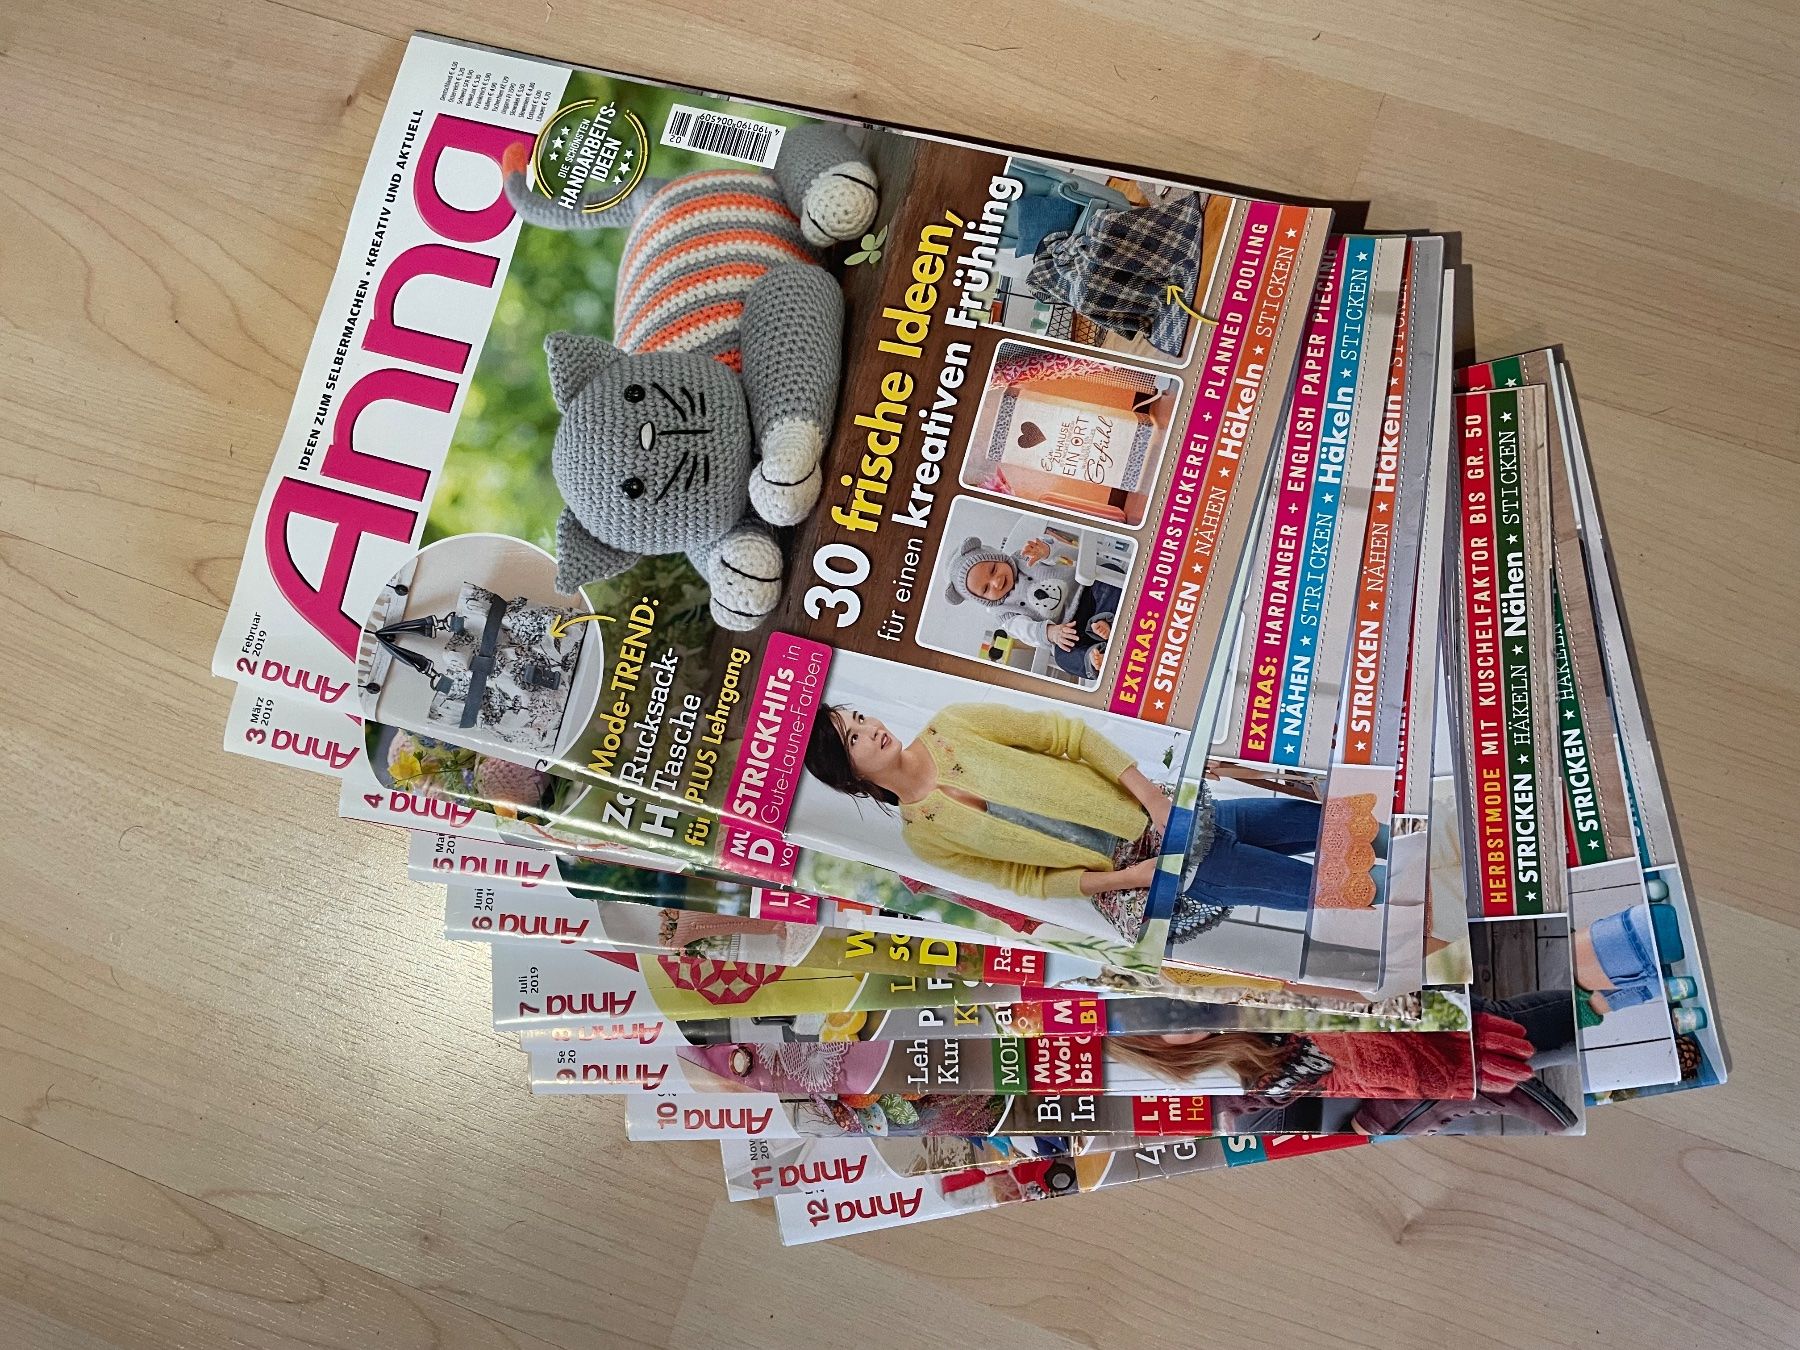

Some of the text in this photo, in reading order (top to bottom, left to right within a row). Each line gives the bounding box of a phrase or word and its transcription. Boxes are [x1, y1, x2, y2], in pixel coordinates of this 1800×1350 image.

[557, 117, 591, 178] DIE SCHÖNSTEN
[557, 97, 619, 210] HANDARBEITS-
[668, 134, 681, 144] 02
[589, 135, 622, 183] IDEEN
[298, 107, 424, 471] IDEEN ZUM SELBERMACHEN KREATIV UND AKTUELL
[1311, 247, 1340, 324] PIECING
[1300, 332, 1327, 396] PAPER
[265, 113, 537, 664] Anna
[877, 169, 1025, 643] für einen kreativen Frühling
[803, 202, 964, 628] 30 frische Ideen,
[1069, 415, 1089, 447] ORT
[1464, 413, 1482, 438] 50
[1039, 448, 1056, 472] Ein
[1052, 421, 1070, 463] ZUHAUSE
[1082, 415, 1124, 486] Gefühl
[1285, 405, 1317, 492] ENGLISH
[1062, 451, 1080, 476] EIN
[1117, 608, 1161, 704] EXTRAS:
[1145, 430, 1211, 602] AJOURSTICKEREI
[1203, 309, 1245, 401] PLANNED
[1231, 220, 1270, 303] POOLING
[1150, 244, 1296, 694] STRICKEN NÄHEN Häkeln STICKEN
[1465, 445, 1484, 479] GR.
[1276, 267, 1370, 736] NÄHEN STRICKEN Häkeln STICKEN
[1467, 491, 1487, 524] BIS
[1364, 522, 1391, 592] NÄHEN
[1263, 523, 1300, 646] HARDANGER
[240, 610, 263, 654] Februar
[1470, 536, 1496, 706] KUSCHELFAKTOR
[251, 629, 268, 656] 2019
[1498, 429, 1538, 883] STRICKEN HÄKELN Nähen STICKEN
[236, 657, 258, 675] 2
[261, 660, 350, 703] Anna
[1349, 618, 1382, 733] STRICKEN
[586, 592, 660, 778] Mode-TREND:
[1246, 654, 1279, 751] EXTRAS:
[250, 697, 264, 724] März
[261, 700, 274, 726] 2019
[618, 642, 681, 786] Rucksack-
[684, 644, 752, 804] PLUS Lehrgang
[246, 728, 267, 744] 3
[271, 728, 360, 769] Anna
[650, 690, 703, 796] Tasche
[731, 642, 801, 819] STRICKHITs in
[758, 648, 825, 826] Gute-Laune-Farben
[1479, 719, 1499, 755] MIT
[1561, 727, 1599, 833] STRICKEN
[364, 793, 384, 808] 4
[389, 791, 477, 828] Anna
[1483, 766, 1508, 903] HERBSTMODE
[433, 858, 454, 872] 5
[460, 856, 550, 888] Anna
[474, 888, 483, 910] Juni
[472, 916, 492, 931] 6
[499, 914, 589, 944] Anna
[531, 967, 539, 994] 2019
[1015, 956, 1035, 973] in
[519, 976, 528, 994] Juli
[519, 1002, 540, 1017] 7
[547, 991, 636, 1018] Anna
[582, 1064, 668, 1090] Anna
[1034, 1038, 1050, 1083] Mus
[1075, 1053, 1092, 1084] bis
[657, 1102, 677, 1129] 10
[684, 1108, 773, 1134] Anna
[1163, 1096, 1181, 1121] mi
[752, 1165, 773, 1190] 11
[779, 1154, 868, 1187] Anna
[807, 1199, 830, 1228] 12
[835, 1188, 923, 1222] Anna
